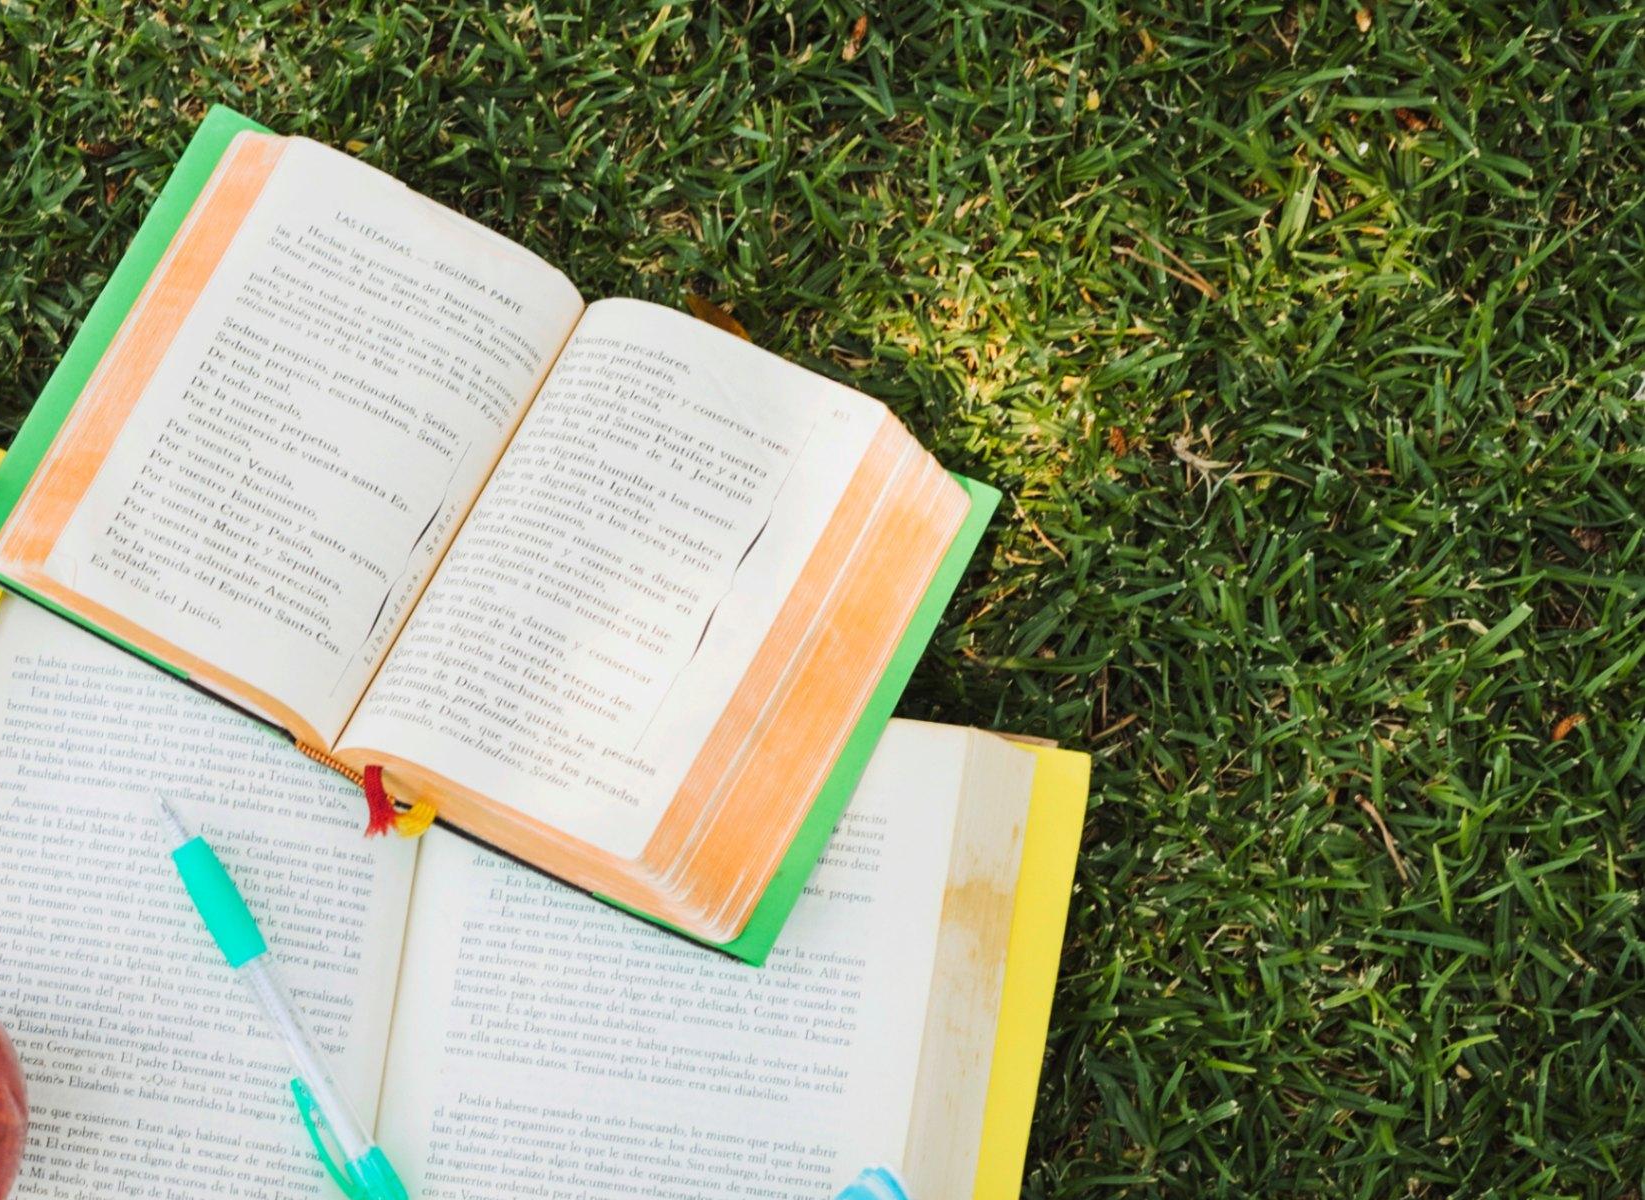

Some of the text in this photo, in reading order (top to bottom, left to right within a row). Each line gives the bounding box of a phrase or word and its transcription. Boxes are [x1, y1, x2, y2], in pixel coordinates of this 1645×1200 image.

[222, 312, 270, 347] Sednos
[198, 358, 219, 377] De
[220, 369, 252, 394] todo
[206, 343, 227, 362] De
[230, 355, 261, 380] todo
[190, 373, 211, 392] De
[211, 384, 227, 401] la
[229, 397, 278, 426] muerte
[157, 430, 181, 452] Por
[186, 449, 235, 479] vuestro
[165, 415, 191, 438] Por
[193, 434, 242, 463] vuestra
[181, 387, 205, 408] Por
[207, 405, 225, 418] el
[222, 413, 279, 446] misterio
[279, 436, 298, 454] de
[300, 450, 349, 479] vuestra
[350, 474, 387, 499] santa
[131, 478, 154, 498] Por
[159, 495, 208, 524] vuestra
[211, 516, 260, 549] Muerte
[262, 546, 273, 559] y
[140, 462, 164, 482] Por
[167, 479, 216, 508] vuestra
[218, 500, 251, 525] Cruz
[252, 521, 264, 535] y
[148, 446, 172, 467] Por
[177, 464, 226, 494] vuestro
[230, 487, 293, 526] Bautismo
[294, 522, 306, 536] y
[309, 529, 347, 554] santo
[89, 551, 110, 571] En
[111, 567, 128, 580] el
[128, 573, 151, 593] día
[113, 510, 137, 530] Por
[142, 527, 191, 556] vuestra
[193, 551, 261, 589] admirable
[104, 525, 130, 546] Por
[131, 537, 145, 553] la
[147, 549, 191, 575] venida
[217, 578, 274, 615] Espíritu
[273, 606, 314, 637] Santo
